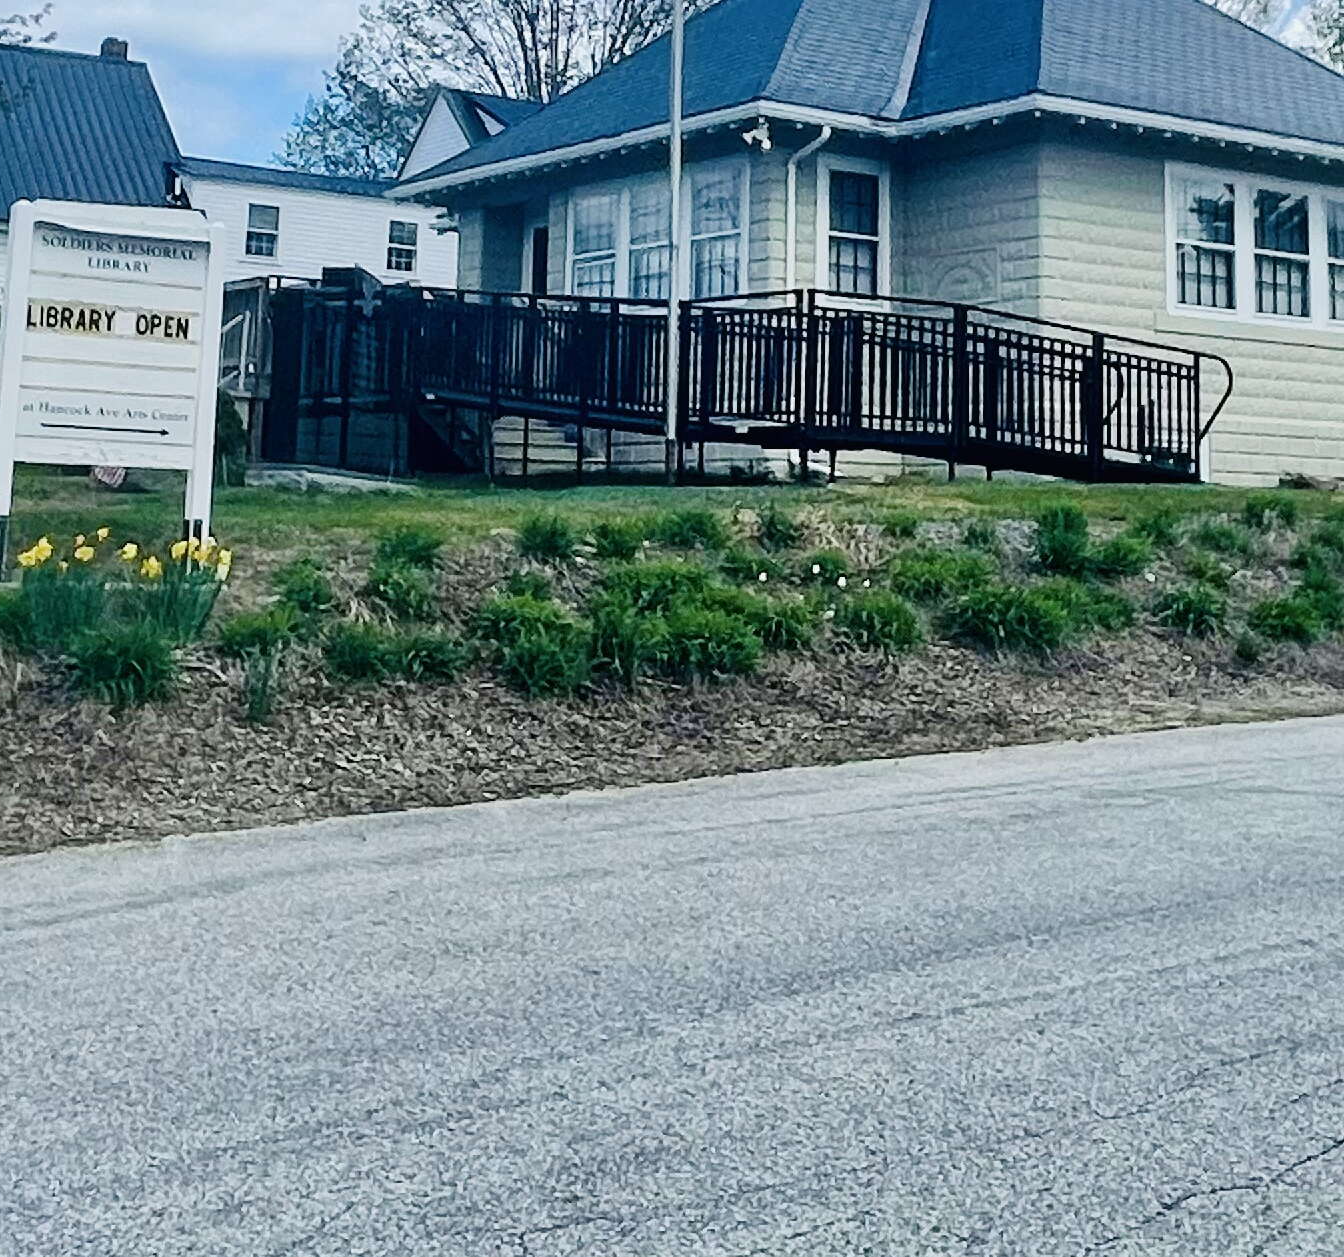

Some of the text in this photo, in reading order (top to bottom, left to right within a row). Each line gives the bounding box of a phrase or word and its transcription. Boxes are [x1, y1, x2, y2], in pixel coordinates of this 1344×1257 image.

[41, 234, 197, 262] SOLDIERS MEMORIAL
[88, 256, 153, 274] LIBRARY
[27, 304, 190, 340] LIBRARY OPEN
[38, 401, 91, 417] Hancock
[95, 406, 119, 419] Ave
